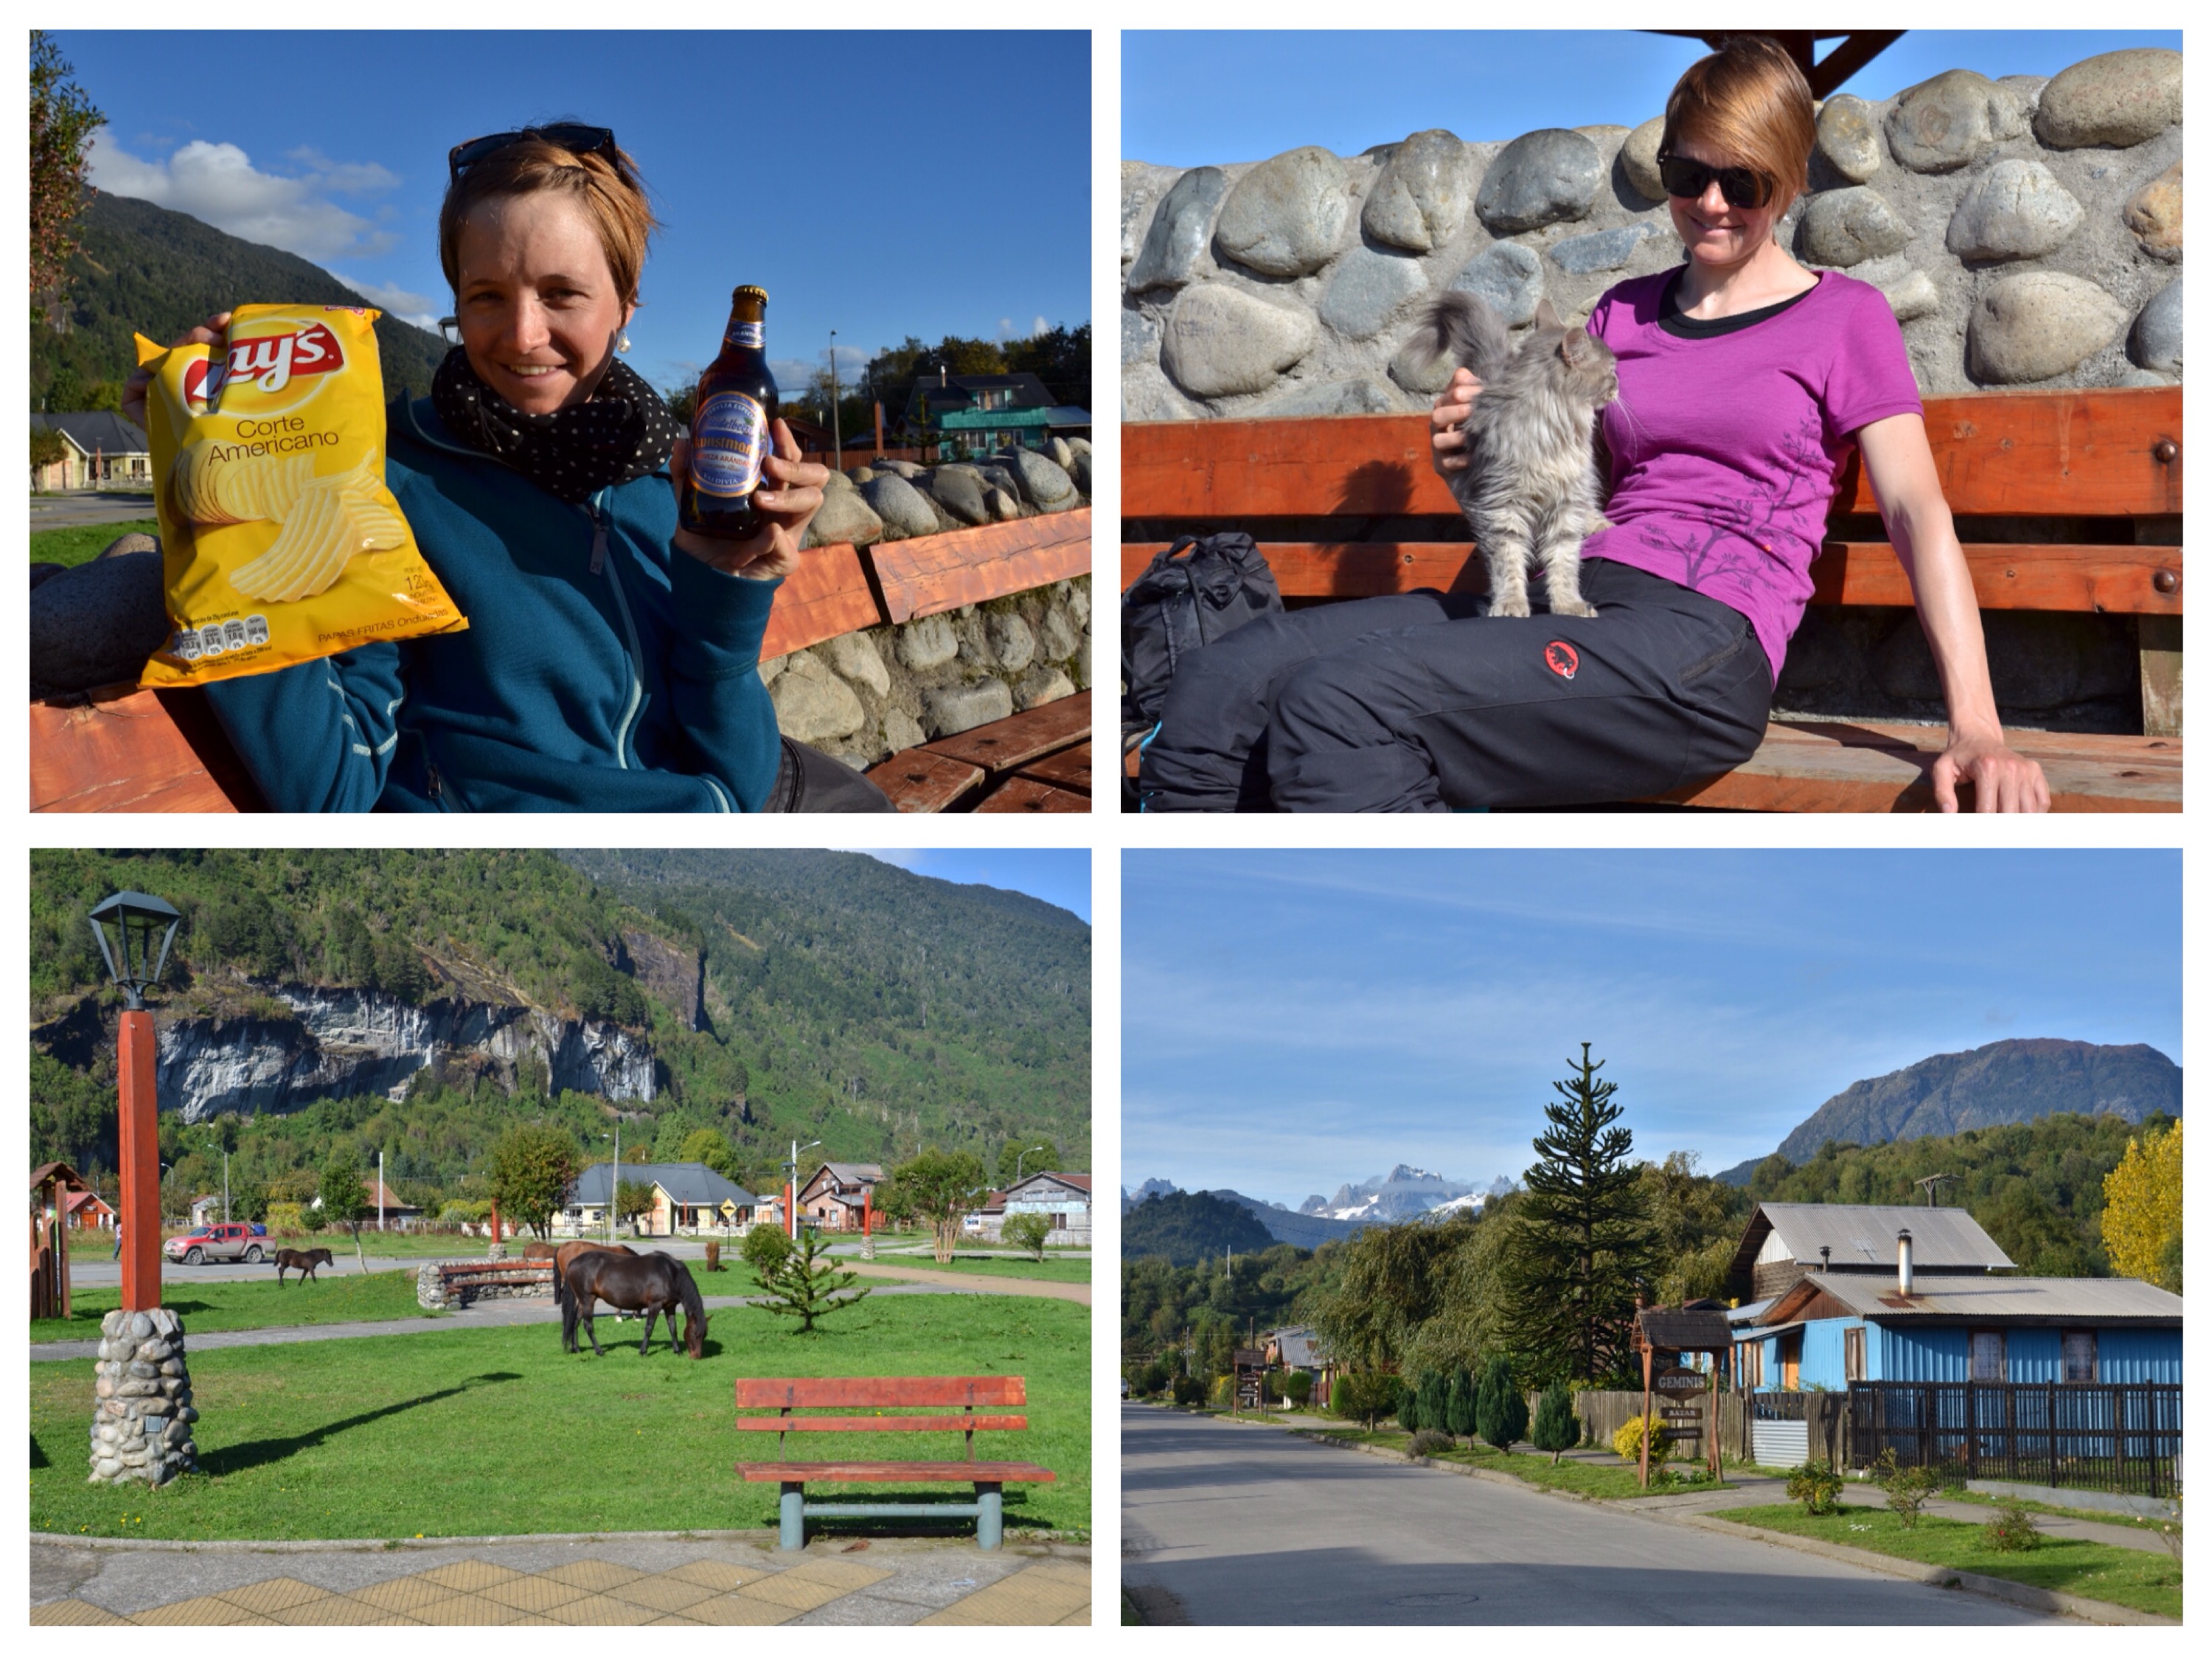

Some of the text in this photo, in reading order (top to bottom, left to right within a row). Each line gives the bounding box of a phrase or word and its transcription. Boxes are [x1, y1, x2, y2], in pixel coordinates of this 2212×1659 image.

[237, 416, 305, 438] Corte
[208, 431, 338, 466] Americano
[318, 608, 448, 642] PAPAS FRITAS Onduladas
[1658, 1376, 1705, 1389] GEMINIS
